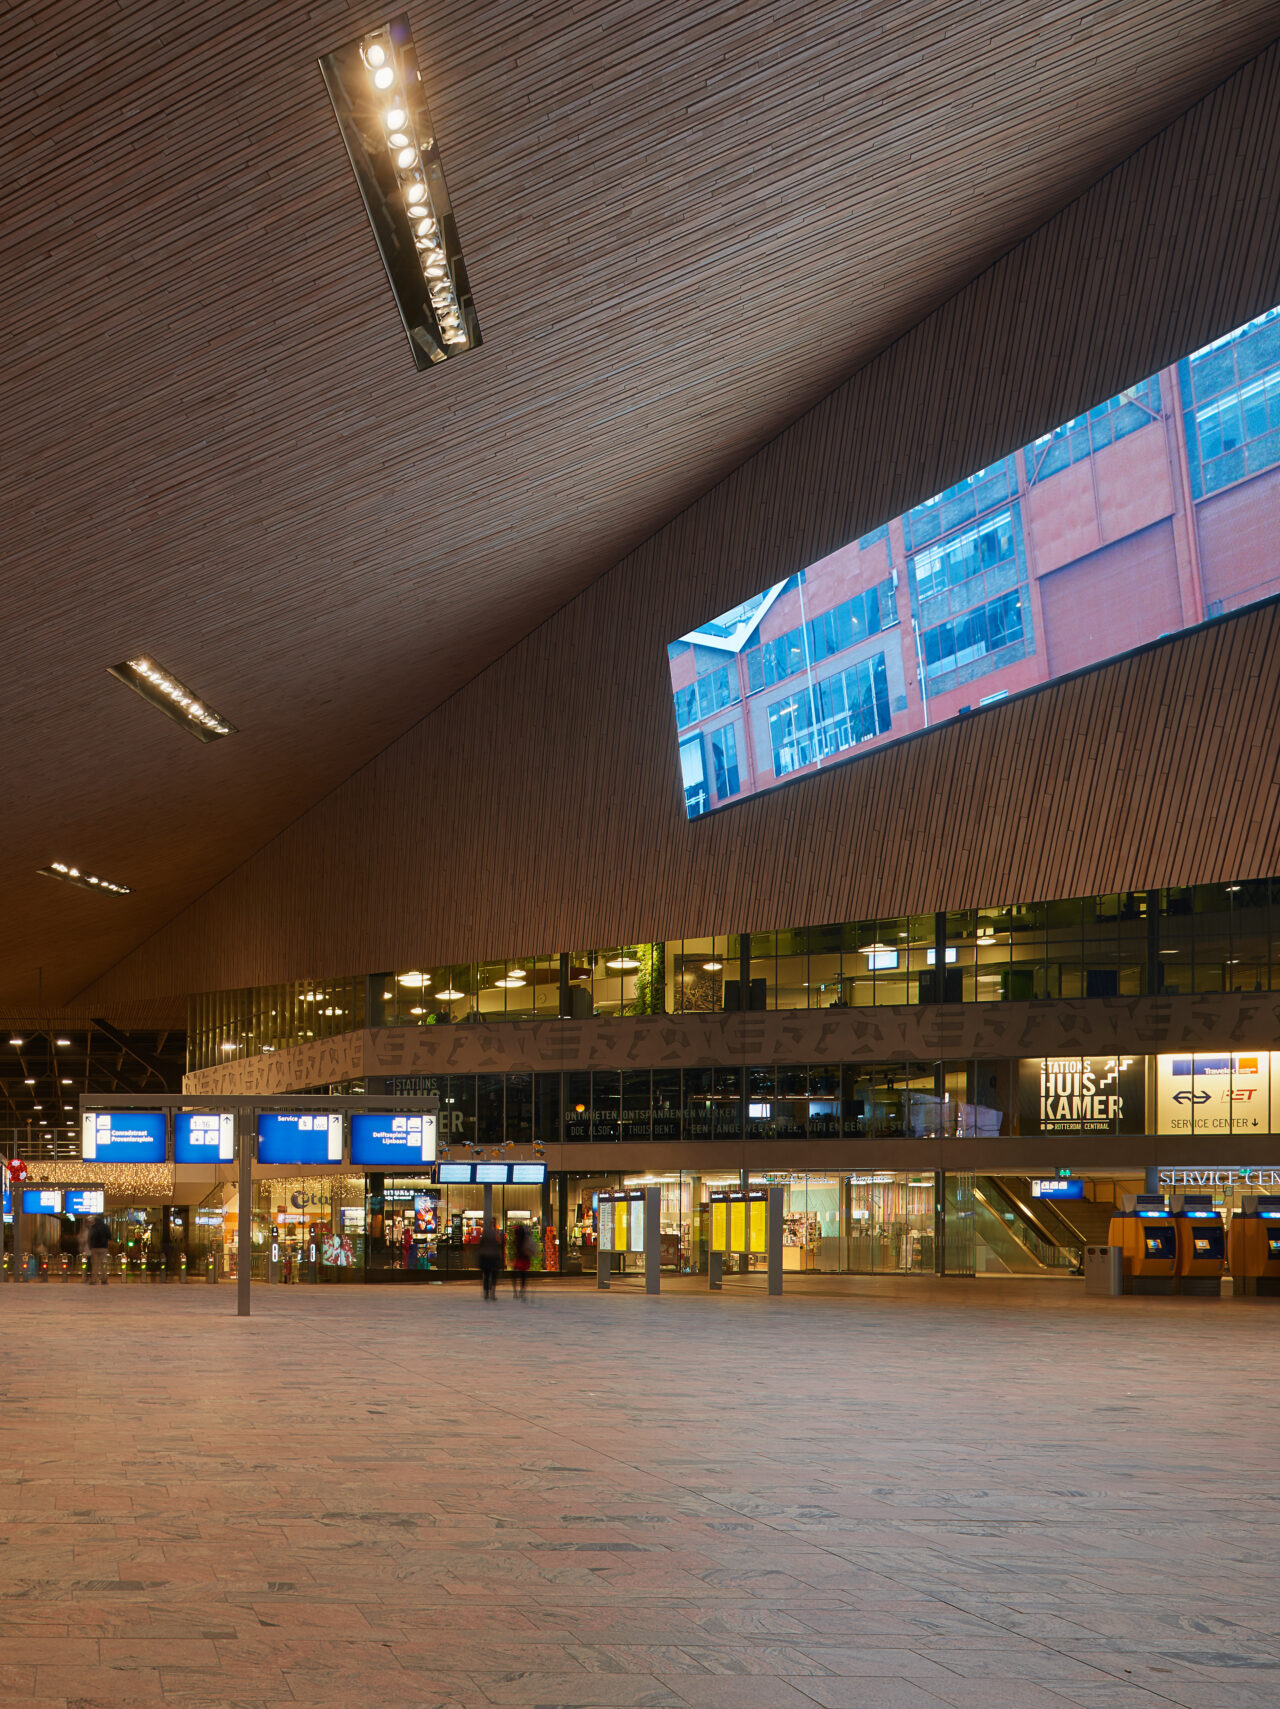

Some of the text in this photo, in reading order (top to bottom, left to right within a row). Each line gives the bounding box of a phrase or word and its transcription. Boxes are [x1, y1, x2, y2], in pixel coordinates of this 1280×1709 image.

[1040, 1061, 1091, 1073] STATIONS
[1040, 1073, 1096, 1096] HUIS
[1040, 1096, 1124, 1119] KAMER
[712, 1123, 741, 1134] ANGE
[1171, 1118, 1249, 1128] SERVICE CENTER
[1160, 1170, 1240, 1186] SERVICE
